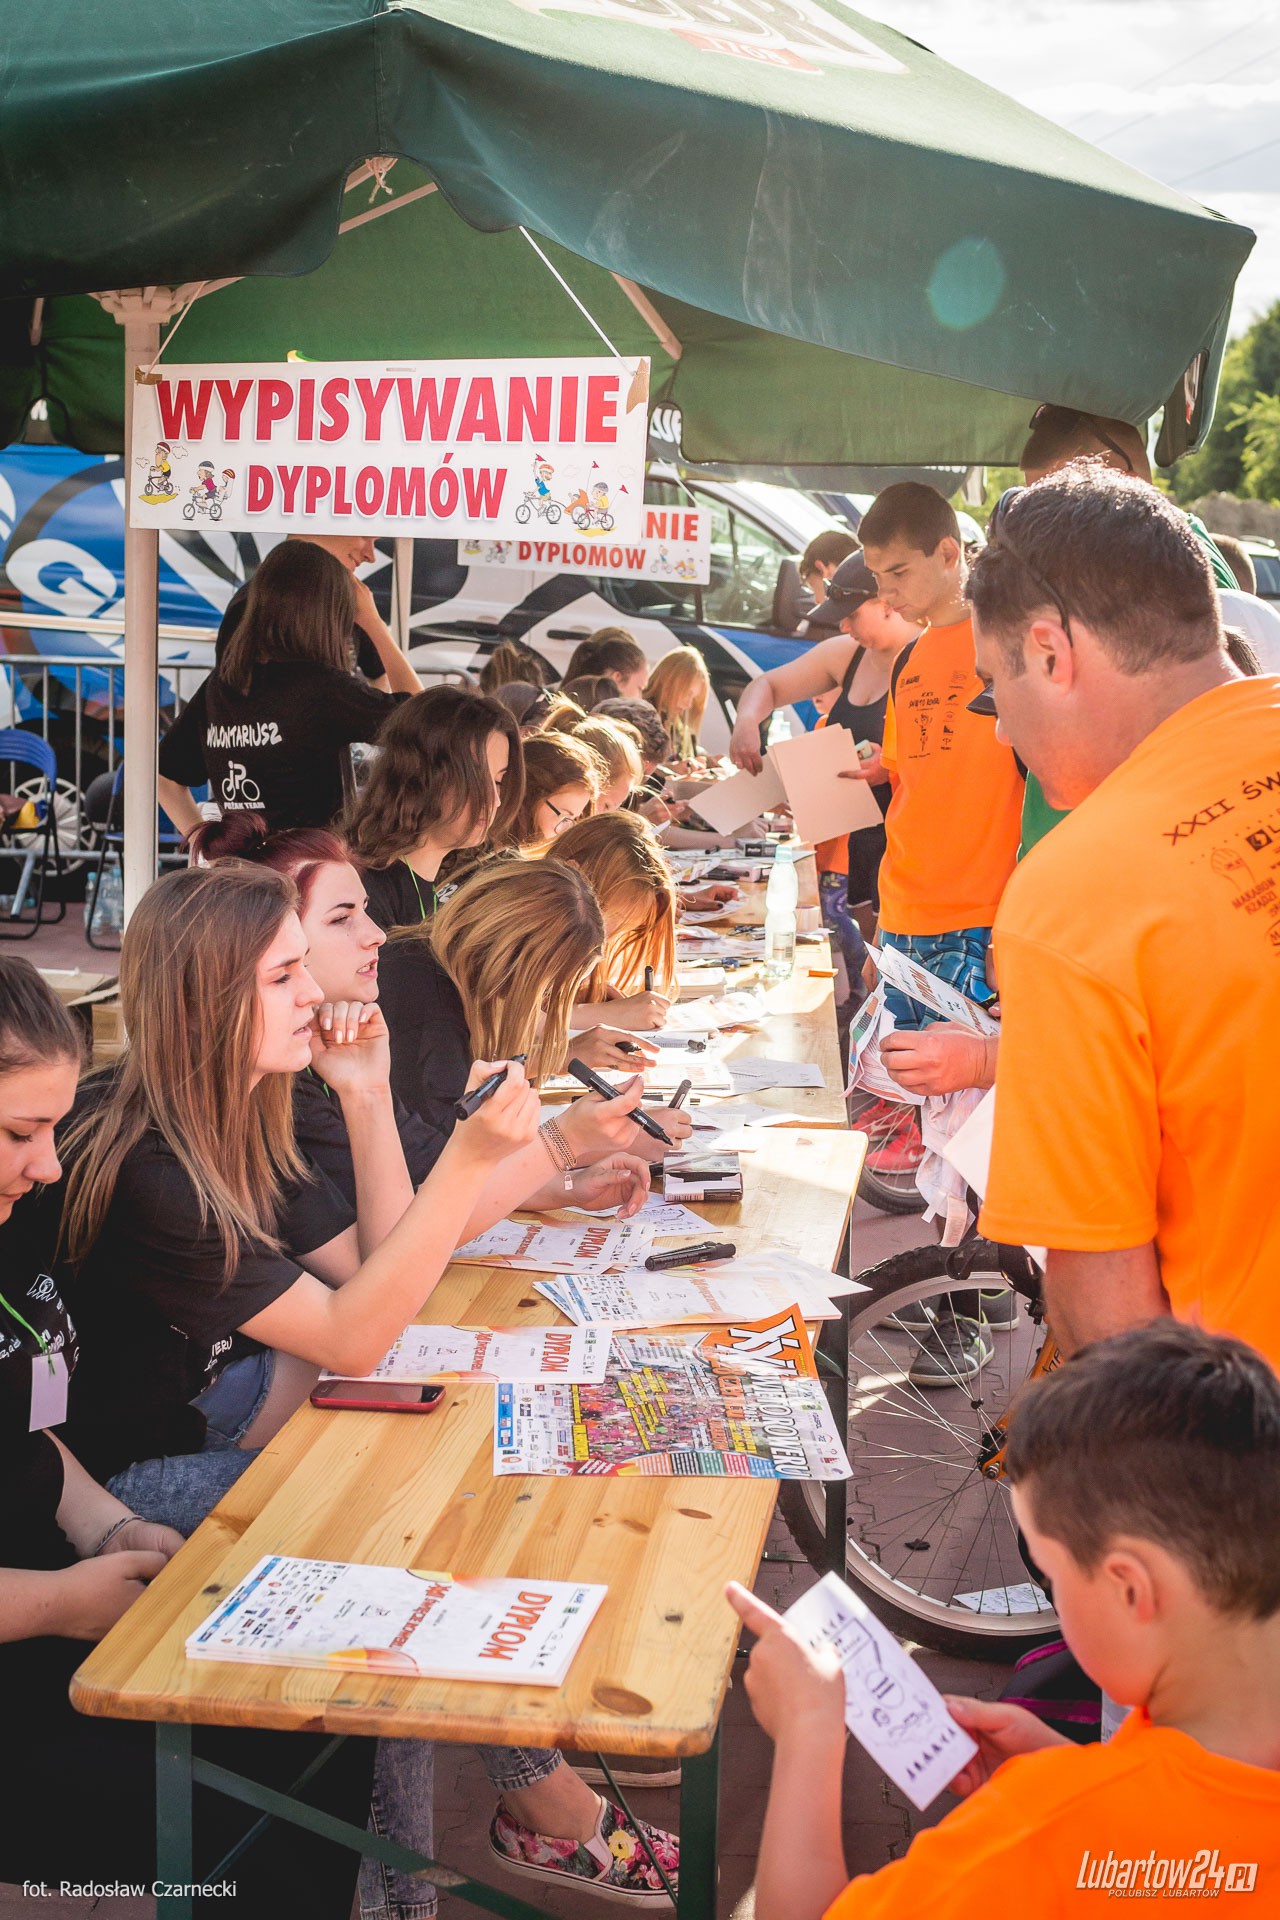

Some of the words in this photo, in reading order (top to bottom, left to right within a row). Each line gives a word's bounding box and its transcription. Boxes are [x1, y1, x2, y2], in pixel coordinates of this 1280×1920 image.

[156, 376, 620, 443] WYPISYWANIE
[247, 453, 508, 519] DYPLOMÓW
[1162, 798, 1236, 847] XXII
[574, 1227, 611, 1259] DYPLOM
[540, 1333, 571, 1372] DYPLOM
[761, 1415, 812, 1478] ROWERU
[478, 1591, 552, 1660] DYPLOM
